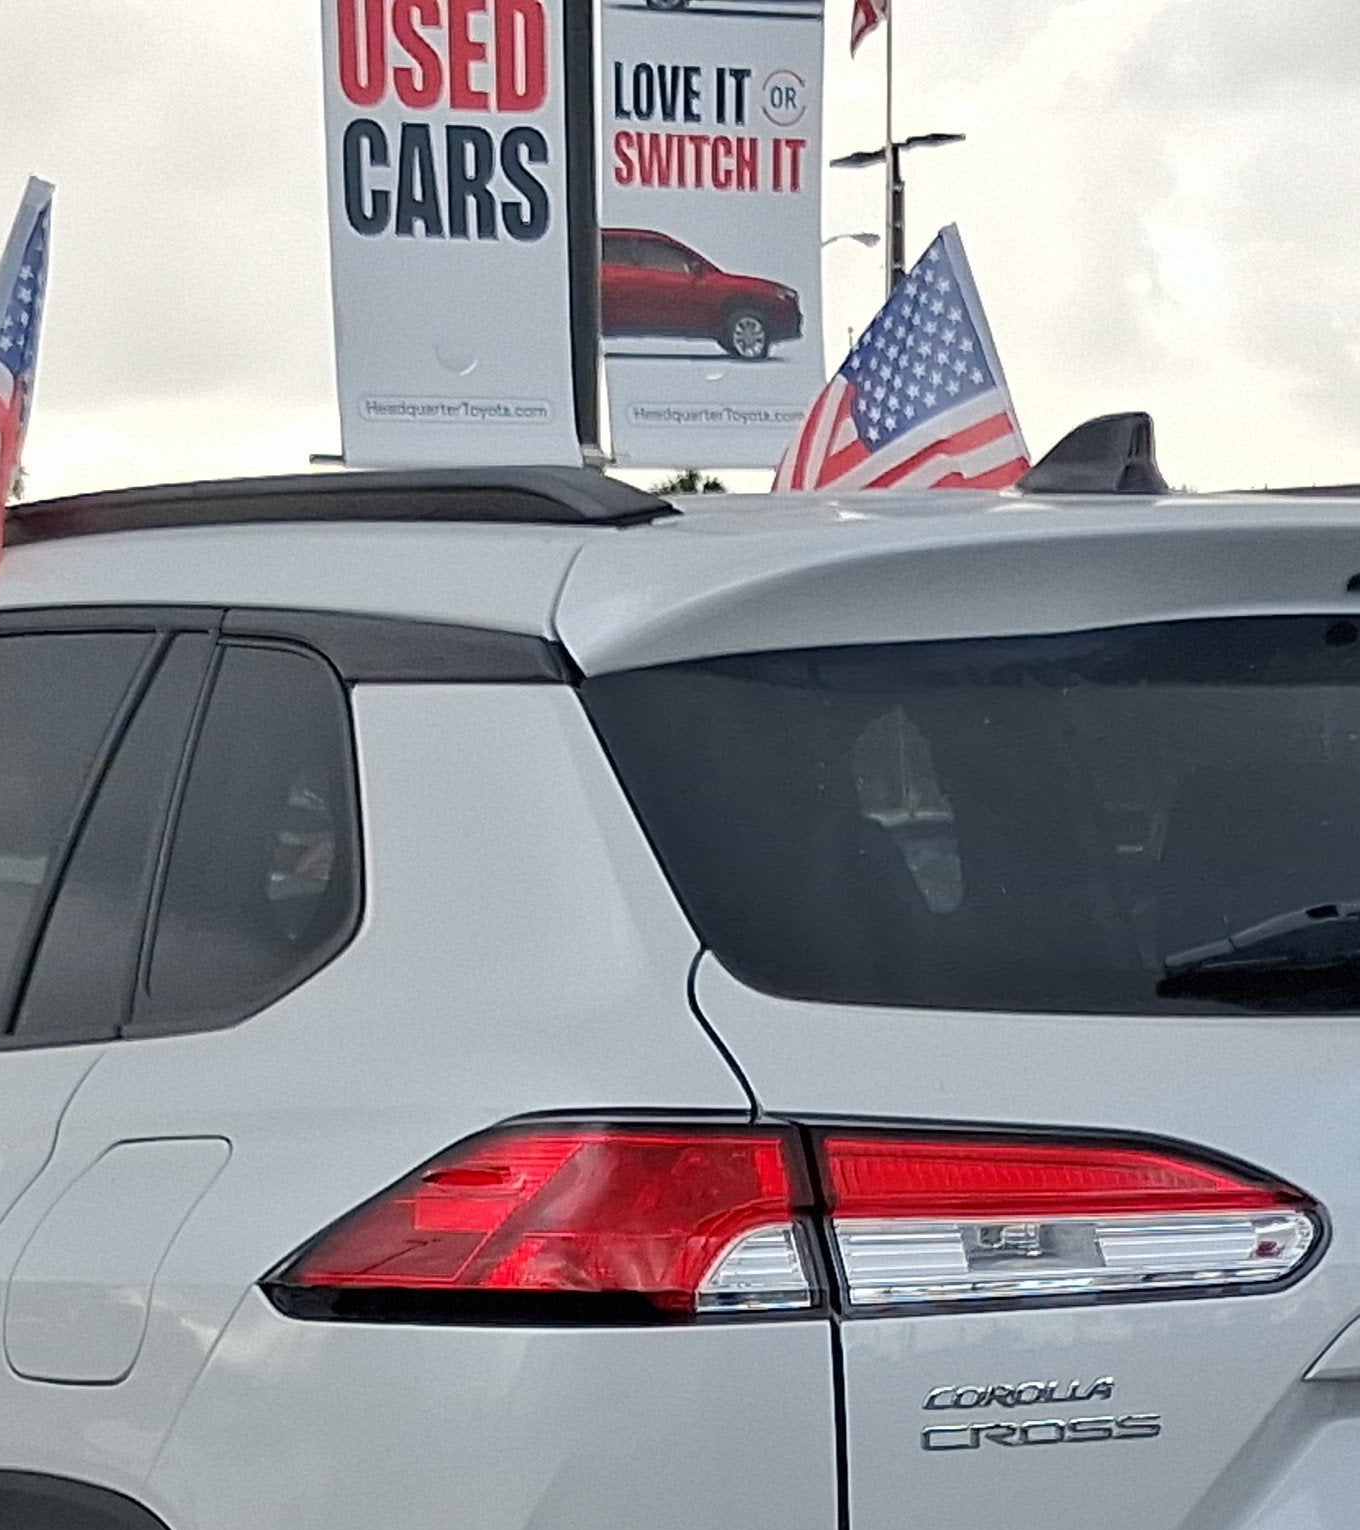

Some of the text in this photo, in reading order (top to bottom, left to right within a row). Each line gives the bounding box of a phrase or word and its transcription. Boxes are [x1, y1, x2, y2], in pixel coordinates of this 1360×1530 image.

[337, 0, 548, 113] USED
[613, 61, 797, 126] LOVE IT OR
[343, 118, 549, 241] CARS
[614, 130, 807, 193] SWITCH IT
[365, 399, 548, 420] HeadquarterToyota.com
[921, 1376, 1115, 1410] COROLLA
[921, 1413, 1162, 1450] CROSS
